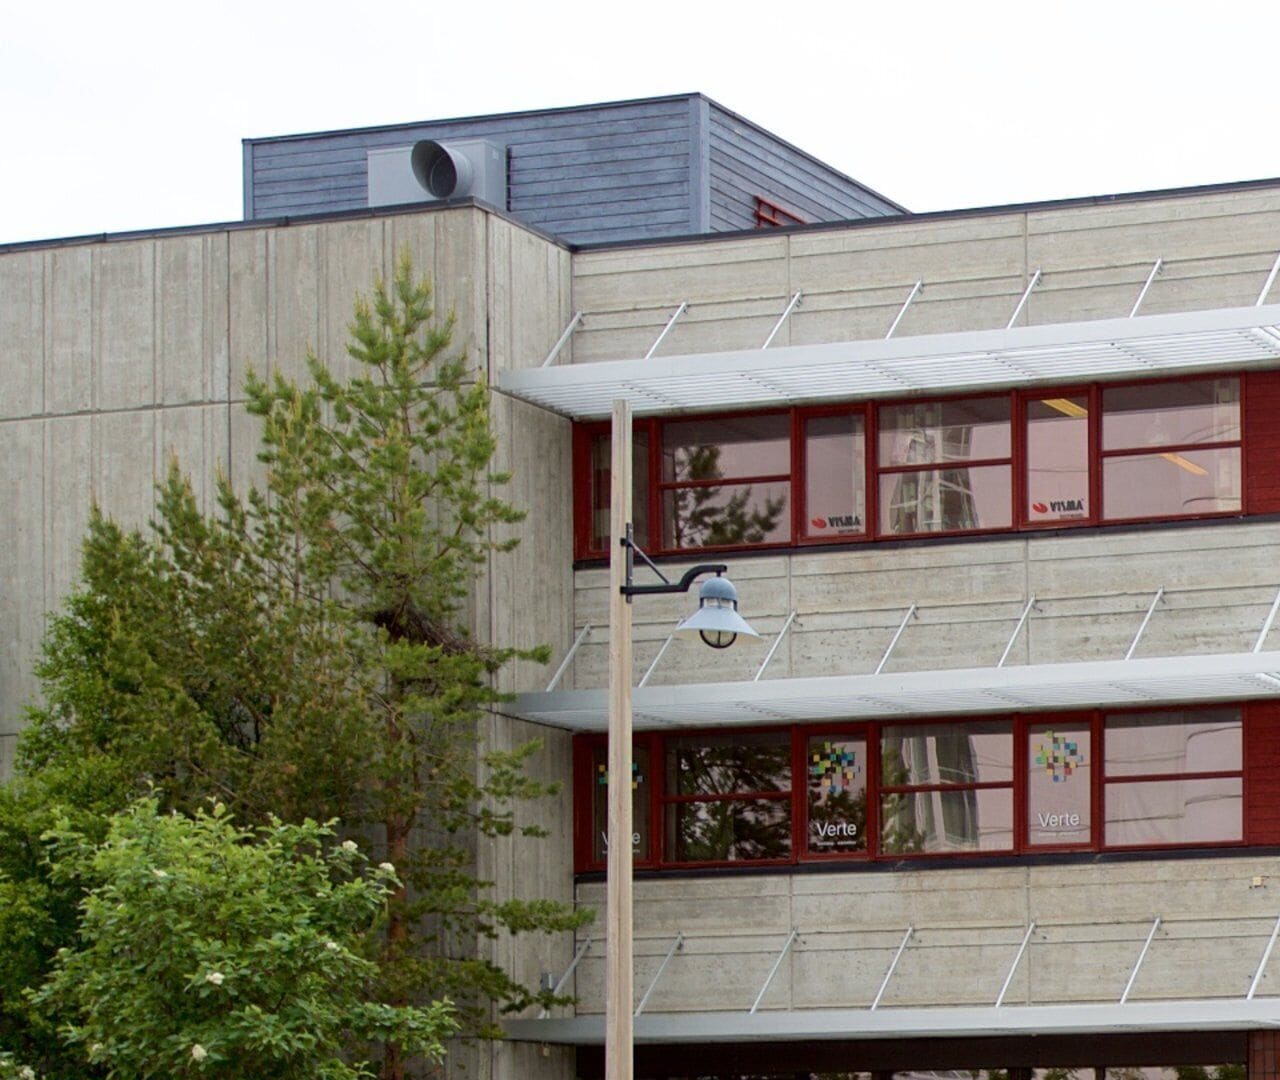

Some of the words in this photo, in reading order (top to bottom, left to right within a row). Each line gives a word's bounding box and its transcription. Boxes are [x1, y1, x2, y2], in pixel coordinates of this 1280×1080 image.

[1050, 500, 1083, 511] VISMA
[1038, 812, 1080, 828] Verte
[816, 822, 857, 837] Verte
